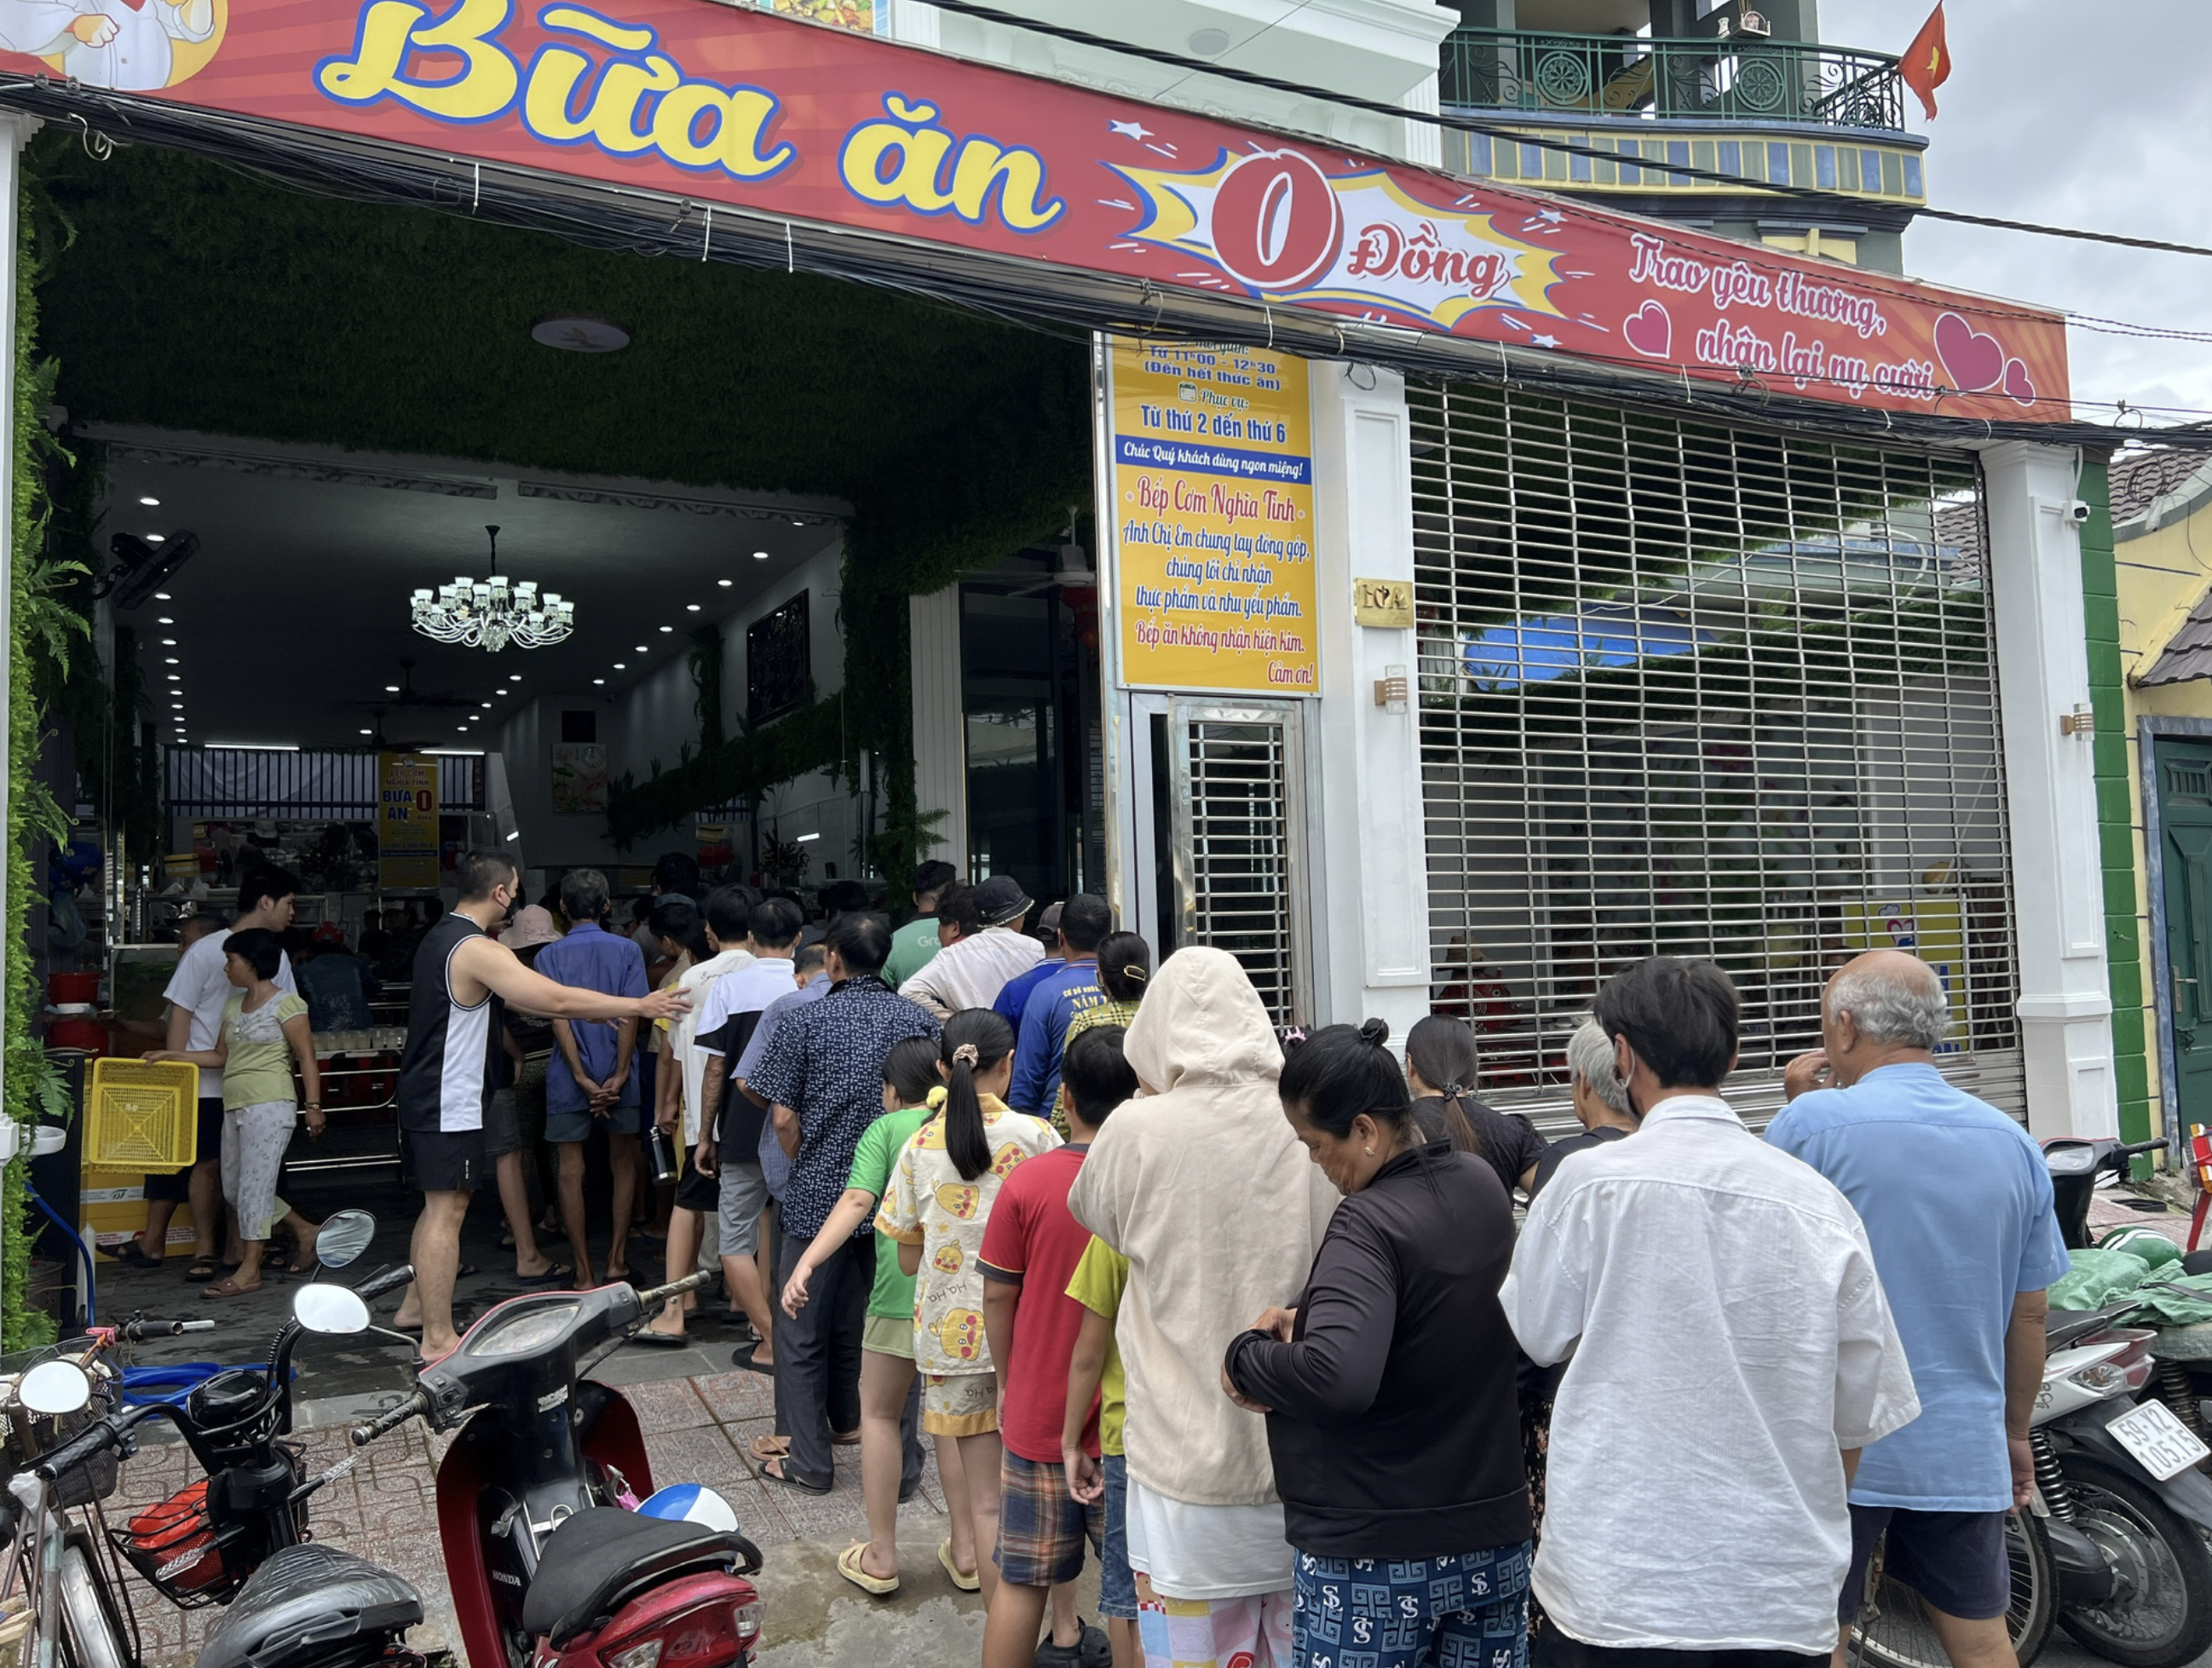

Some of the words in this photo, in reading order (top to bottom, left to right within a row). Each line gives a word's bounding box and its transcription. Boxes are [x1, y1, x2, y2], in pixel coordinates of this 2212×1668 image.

[314, 0, 795, 180] Bữa
[839, 91, 1067, 234] ăn
[1347, 219, 1511, 302] Đồng
[1629, 233, 1708, 294] Trao
[1710, 261, 1772, 309] yêu
[1776, 271, 1887, 338] thương,
[1144, 359, 1182, 377] (Đến
[1187, 367, 1213, 381] hết
[1217, 371, 1251, 386] thức
[1256, 376, 1281, 391] ăn)
[1233, 359, 1276, 375] 12h30
[1781, 331, 1825, 390] lại
[1829, 354, 1869, 400] nụ
[1874, 359, 1936, 401] cười
[1200, 388, 1230, 409] Phục
[1231, 396, 1249, 411] vụ:
[1140, 405, 1161, 428] Từ
[1166, 409, 1192, 432] thứ
[1197, 412, 1207, 434] 2
[1213, 411, 1241, 437] đến
[1247, 418, 1272, 441] thứ
[1276, 423, 1286, 443] 6
[1124, 441, 1151, 458] Chúc
[1152, 445, 1176, 466] Quý
[1178, 449, 1210, 466] khách
[1213, 453, 1240, 472] dùng
[1241, 458, 1267, 475] ngon
[1268, 463, 1304, 480] miệng!
[1137, 475, 1168, 517] Bếp
[1174, 480, 1207, 514] Cơm
[1211, 483, 1259, 525] Nghĩa
[1263, 489, 1295, 522] Tình
[1123, 520, 1149, 545] Anh
[1151, 521, 1172, 551] Chị
[1175, 523, 1193, 548] Em
[1195, 527, 1231, 557] chung
[1234, 532, 1253, 559] tay
[1255, 532, 1284, 562] đóng
[1286, 536, 1310, 563] góp,
[1166, 556, 1203, 585] chúng
[1206, 560, 1220, 581] tôi
[1222, 559, 1239, 582] chỉ
[1241, 562, 1272, 589] nhận
[1136, 584, 1162, 613] thực
[1164, 584, 1199, 614] phẩm
[1201, 589, 1216, 611] và
[1218, 592, 1241, 613] nhu
[1243, 589, 1265, 620] yếu
[1265, 591, 1303, 621] phẩm.
[1135, 618, 1160, 651] Bếp
[1162, 623, 1178, 646] ăn
[1180, 624, 1218, 654] không
[1220, 627, 1251, 655] nhận
[1253, 628, 1278, 656] hiện
[1279, 630, 1305, 653] kim.
[1268, 659, 1294, 684] Cảm
[1295, 663, 1314, 685] ơn!
[2139, 1429, 2201, 1475] 105.15
[492, 1569, 522, 1586] HONDA
